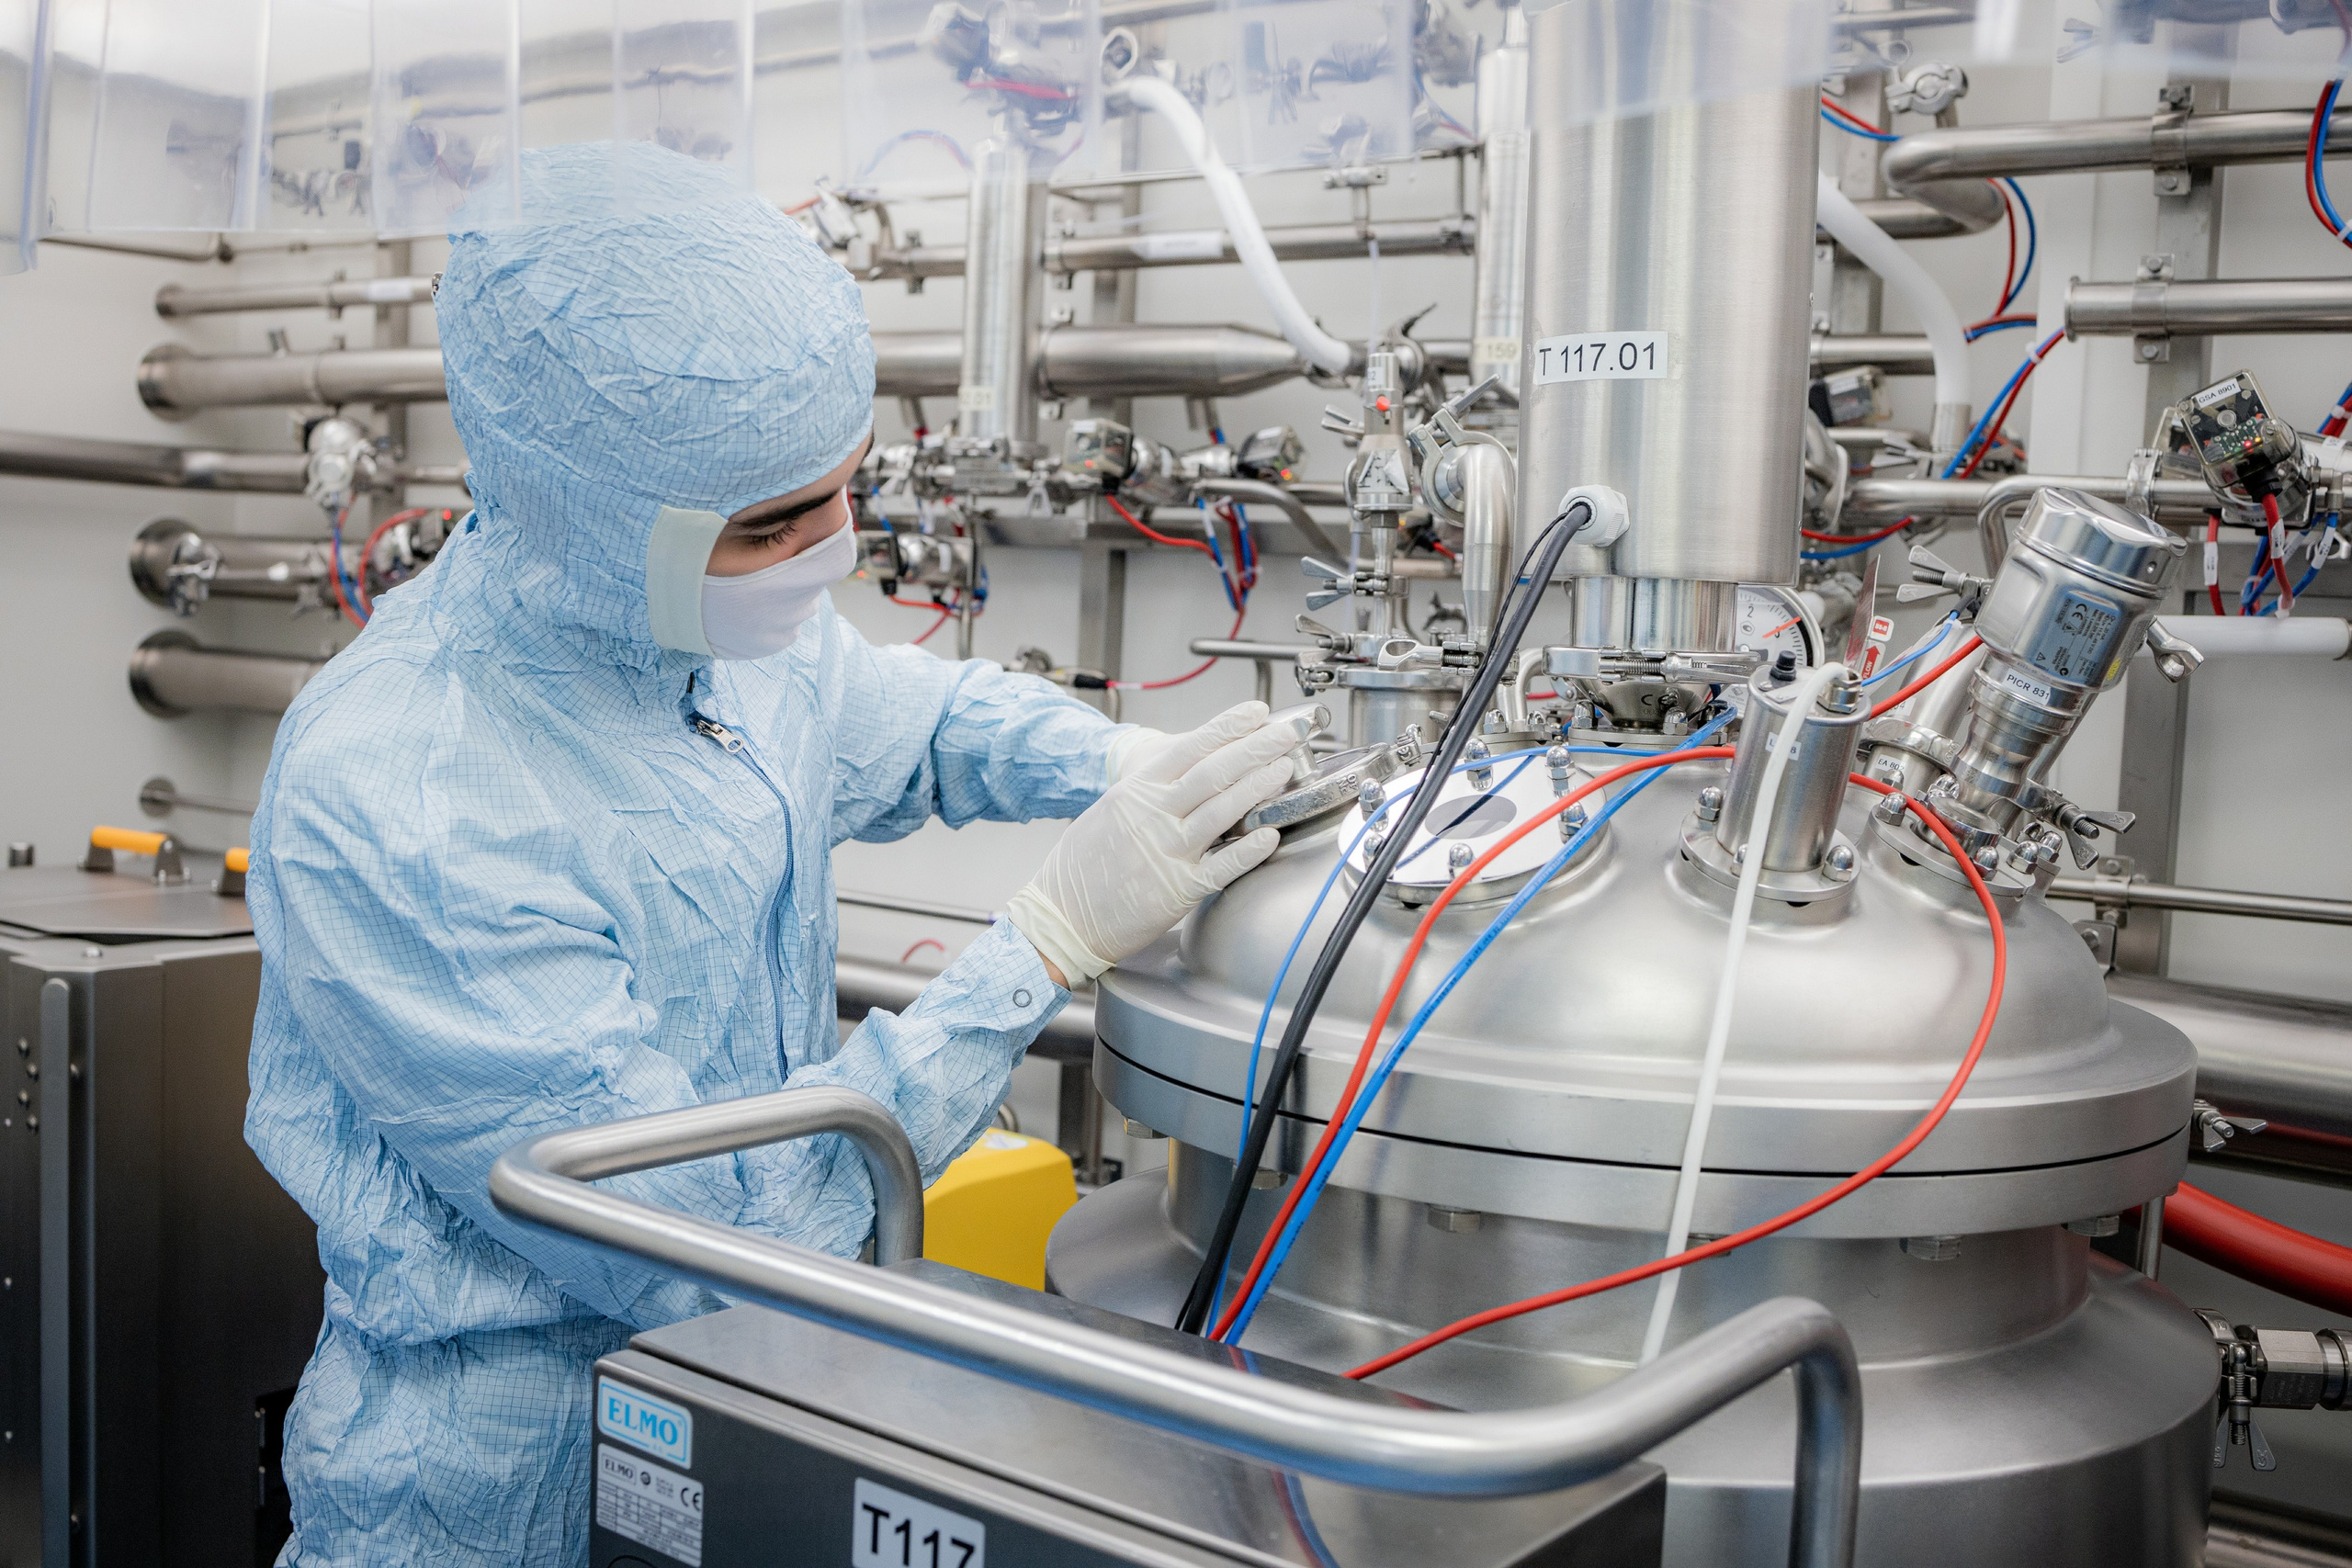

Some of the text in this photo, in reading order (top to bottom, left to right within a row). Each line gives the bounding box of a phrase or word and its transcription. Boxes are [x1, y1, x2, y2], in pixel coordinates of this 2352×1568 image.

[1539, 341, 1655, 376] T 117.01
[2199, 383, 2236, 403] GSA 8901
[1863, 660, 1872, 679] FLOW
[2007, 674, 2050, 700] PICR 831
[1878, 758, 1905, 772] EA 802
[608, 1396, 679, 1446] ELMO
[605, 1459, 634, 1479] ELMO
[862, 1502, 976, 1568] T117
